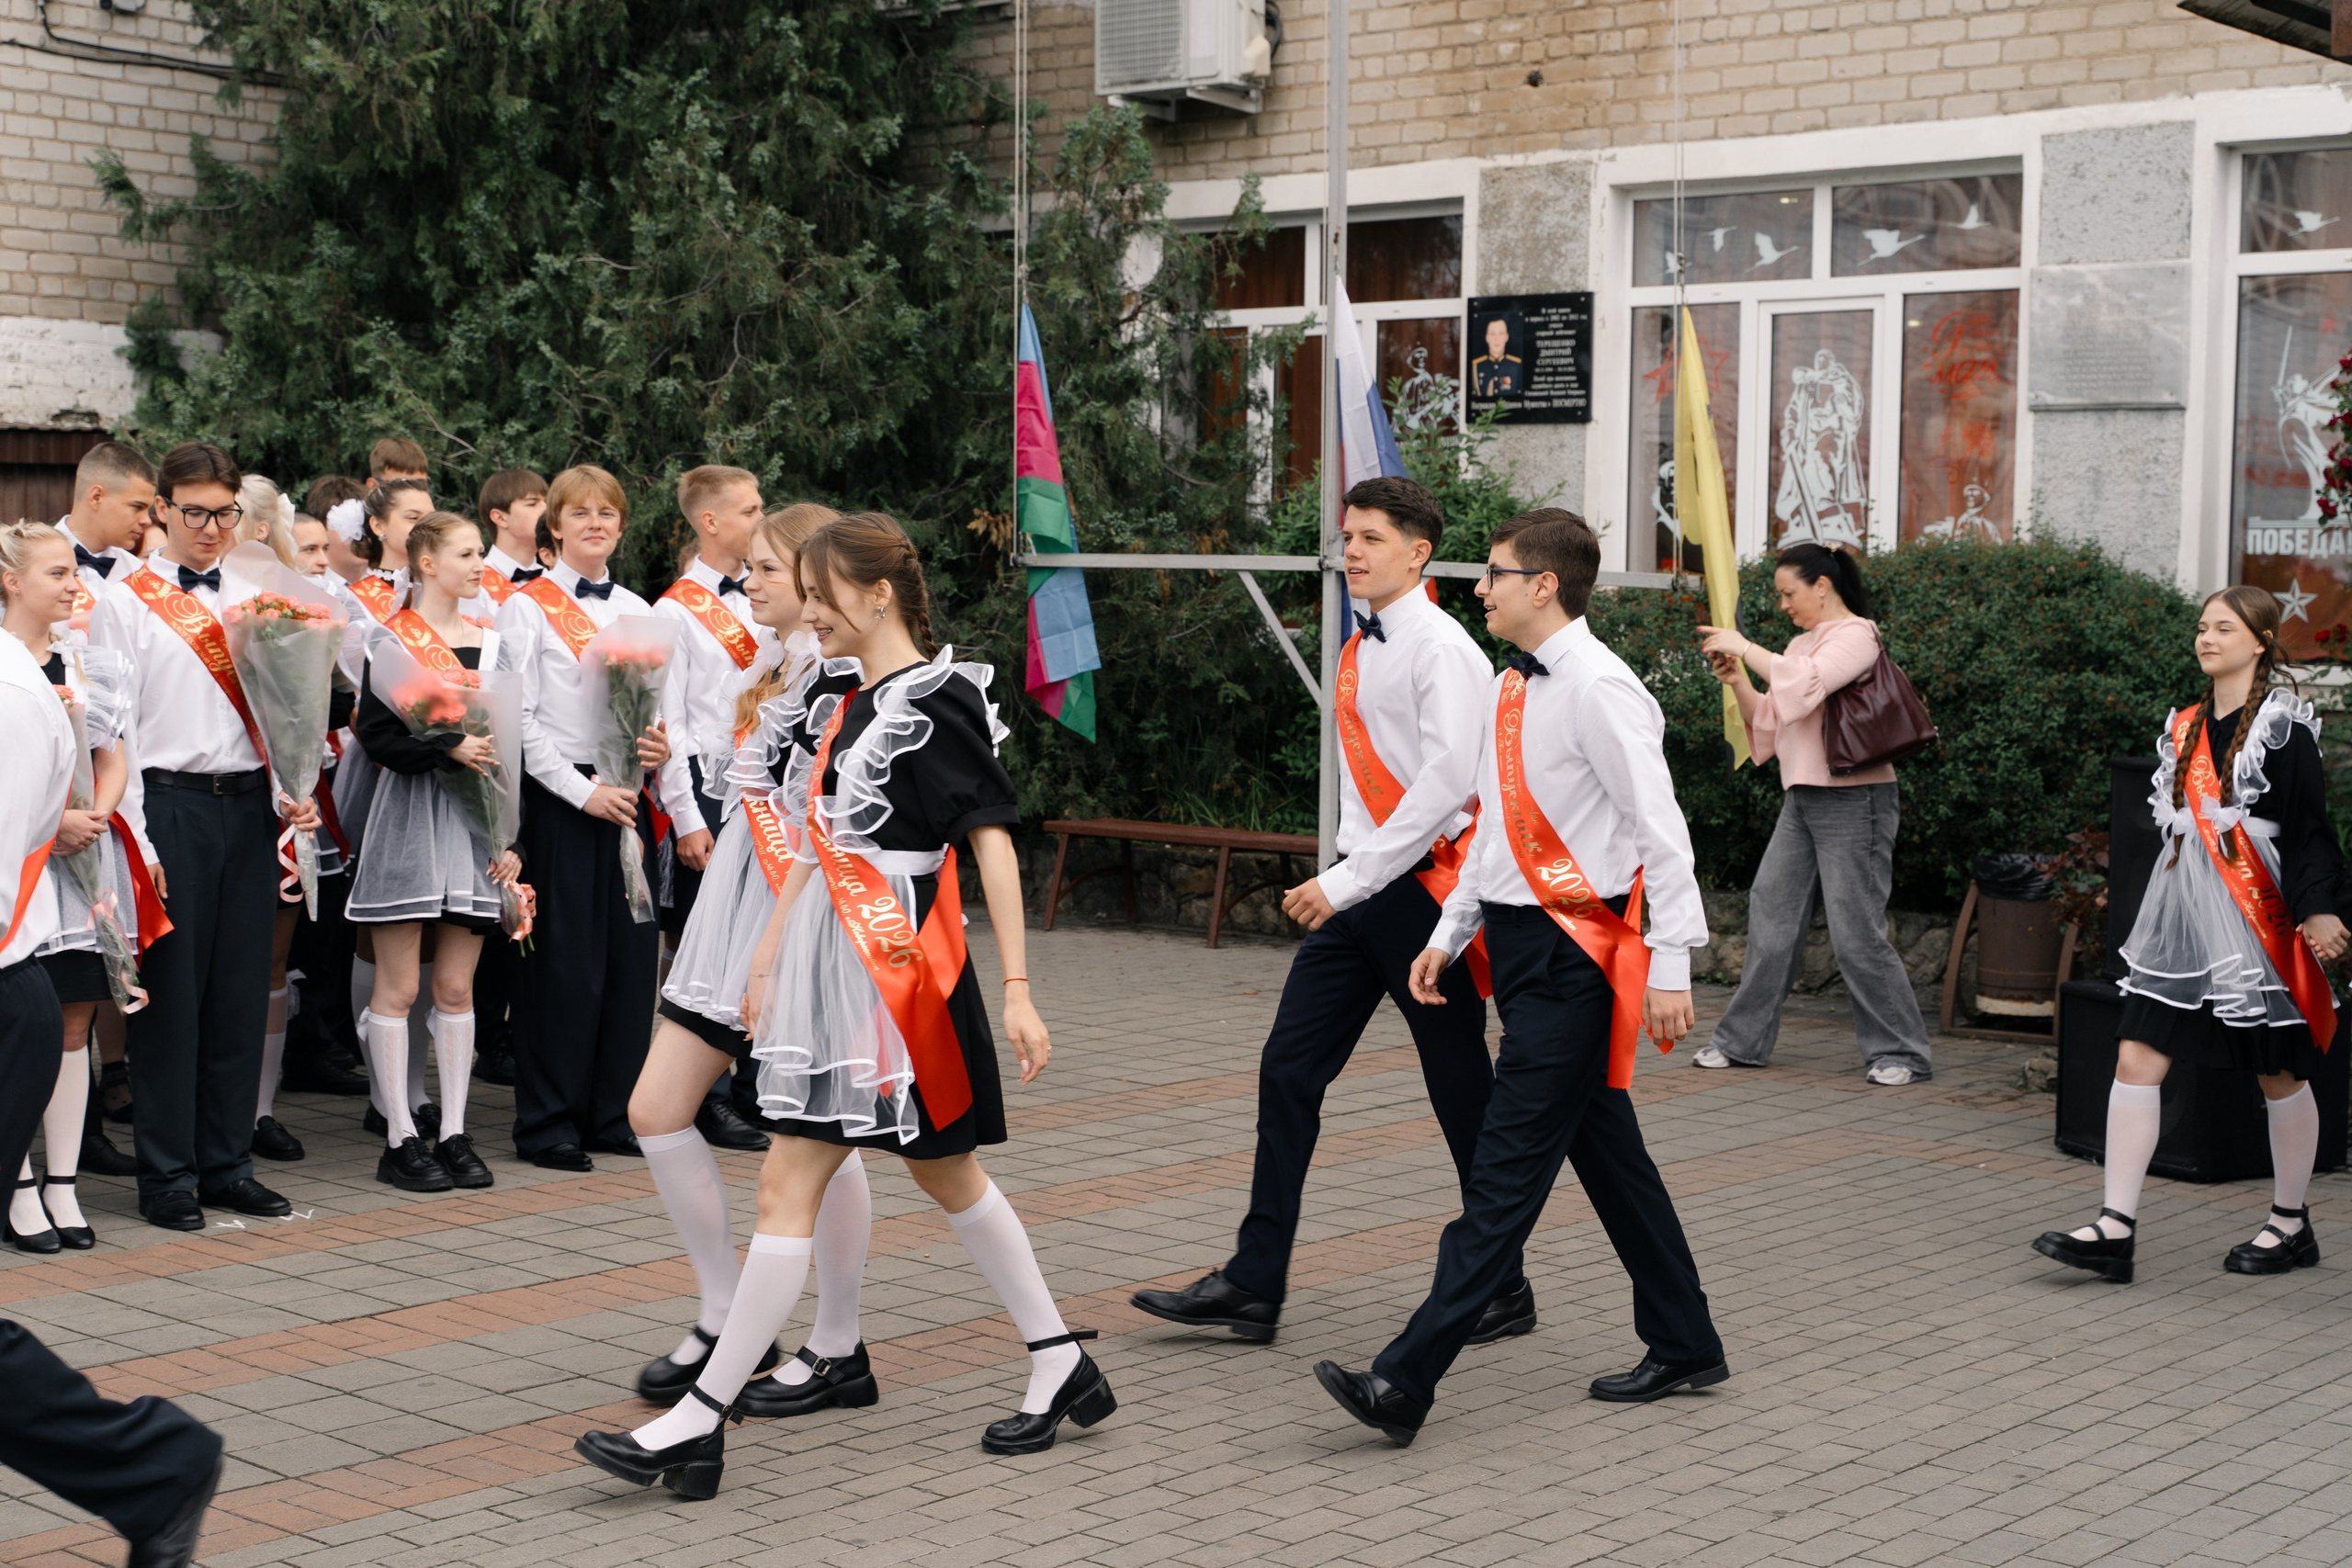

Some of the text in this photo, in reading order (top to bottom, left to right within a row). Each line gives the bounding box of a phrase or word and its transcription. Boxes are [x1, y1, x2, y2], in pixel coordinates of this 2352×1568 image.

[1501, 708, 1604, 919] Выпускник 2026
[856, 897, 924, 968] 2026
